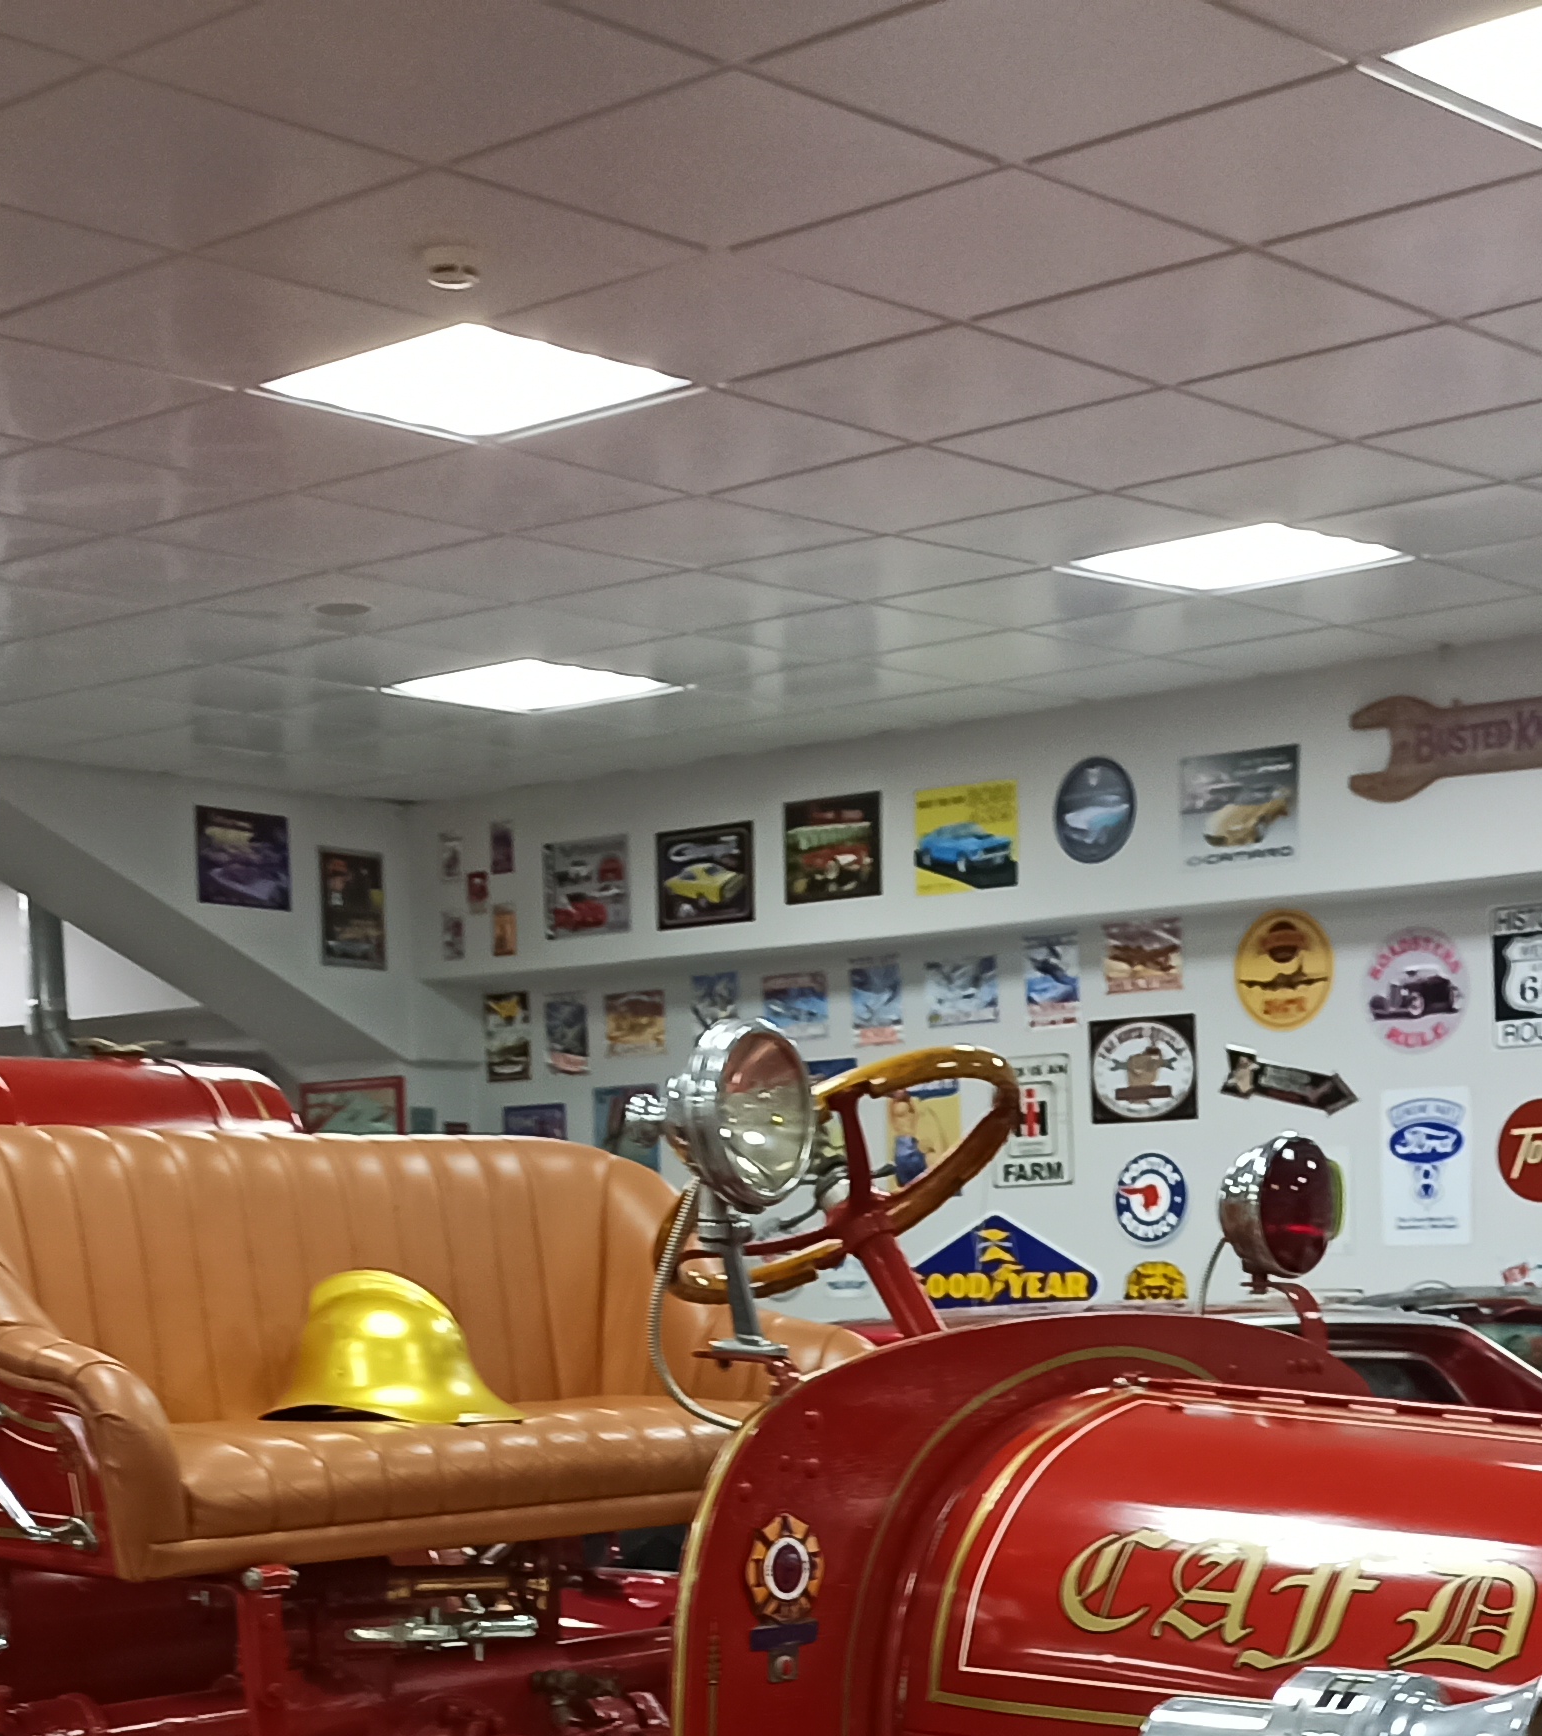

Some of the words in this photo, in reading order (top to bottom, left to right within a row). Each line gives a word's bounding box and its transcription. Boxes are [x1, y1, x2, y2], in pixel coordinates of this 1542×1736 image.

[1414, 719, 1509, 765] BUSTED
[1002, 1161, 1065, 1183] FARM
[915, 1268, 1089, 1300] OODYEAR
